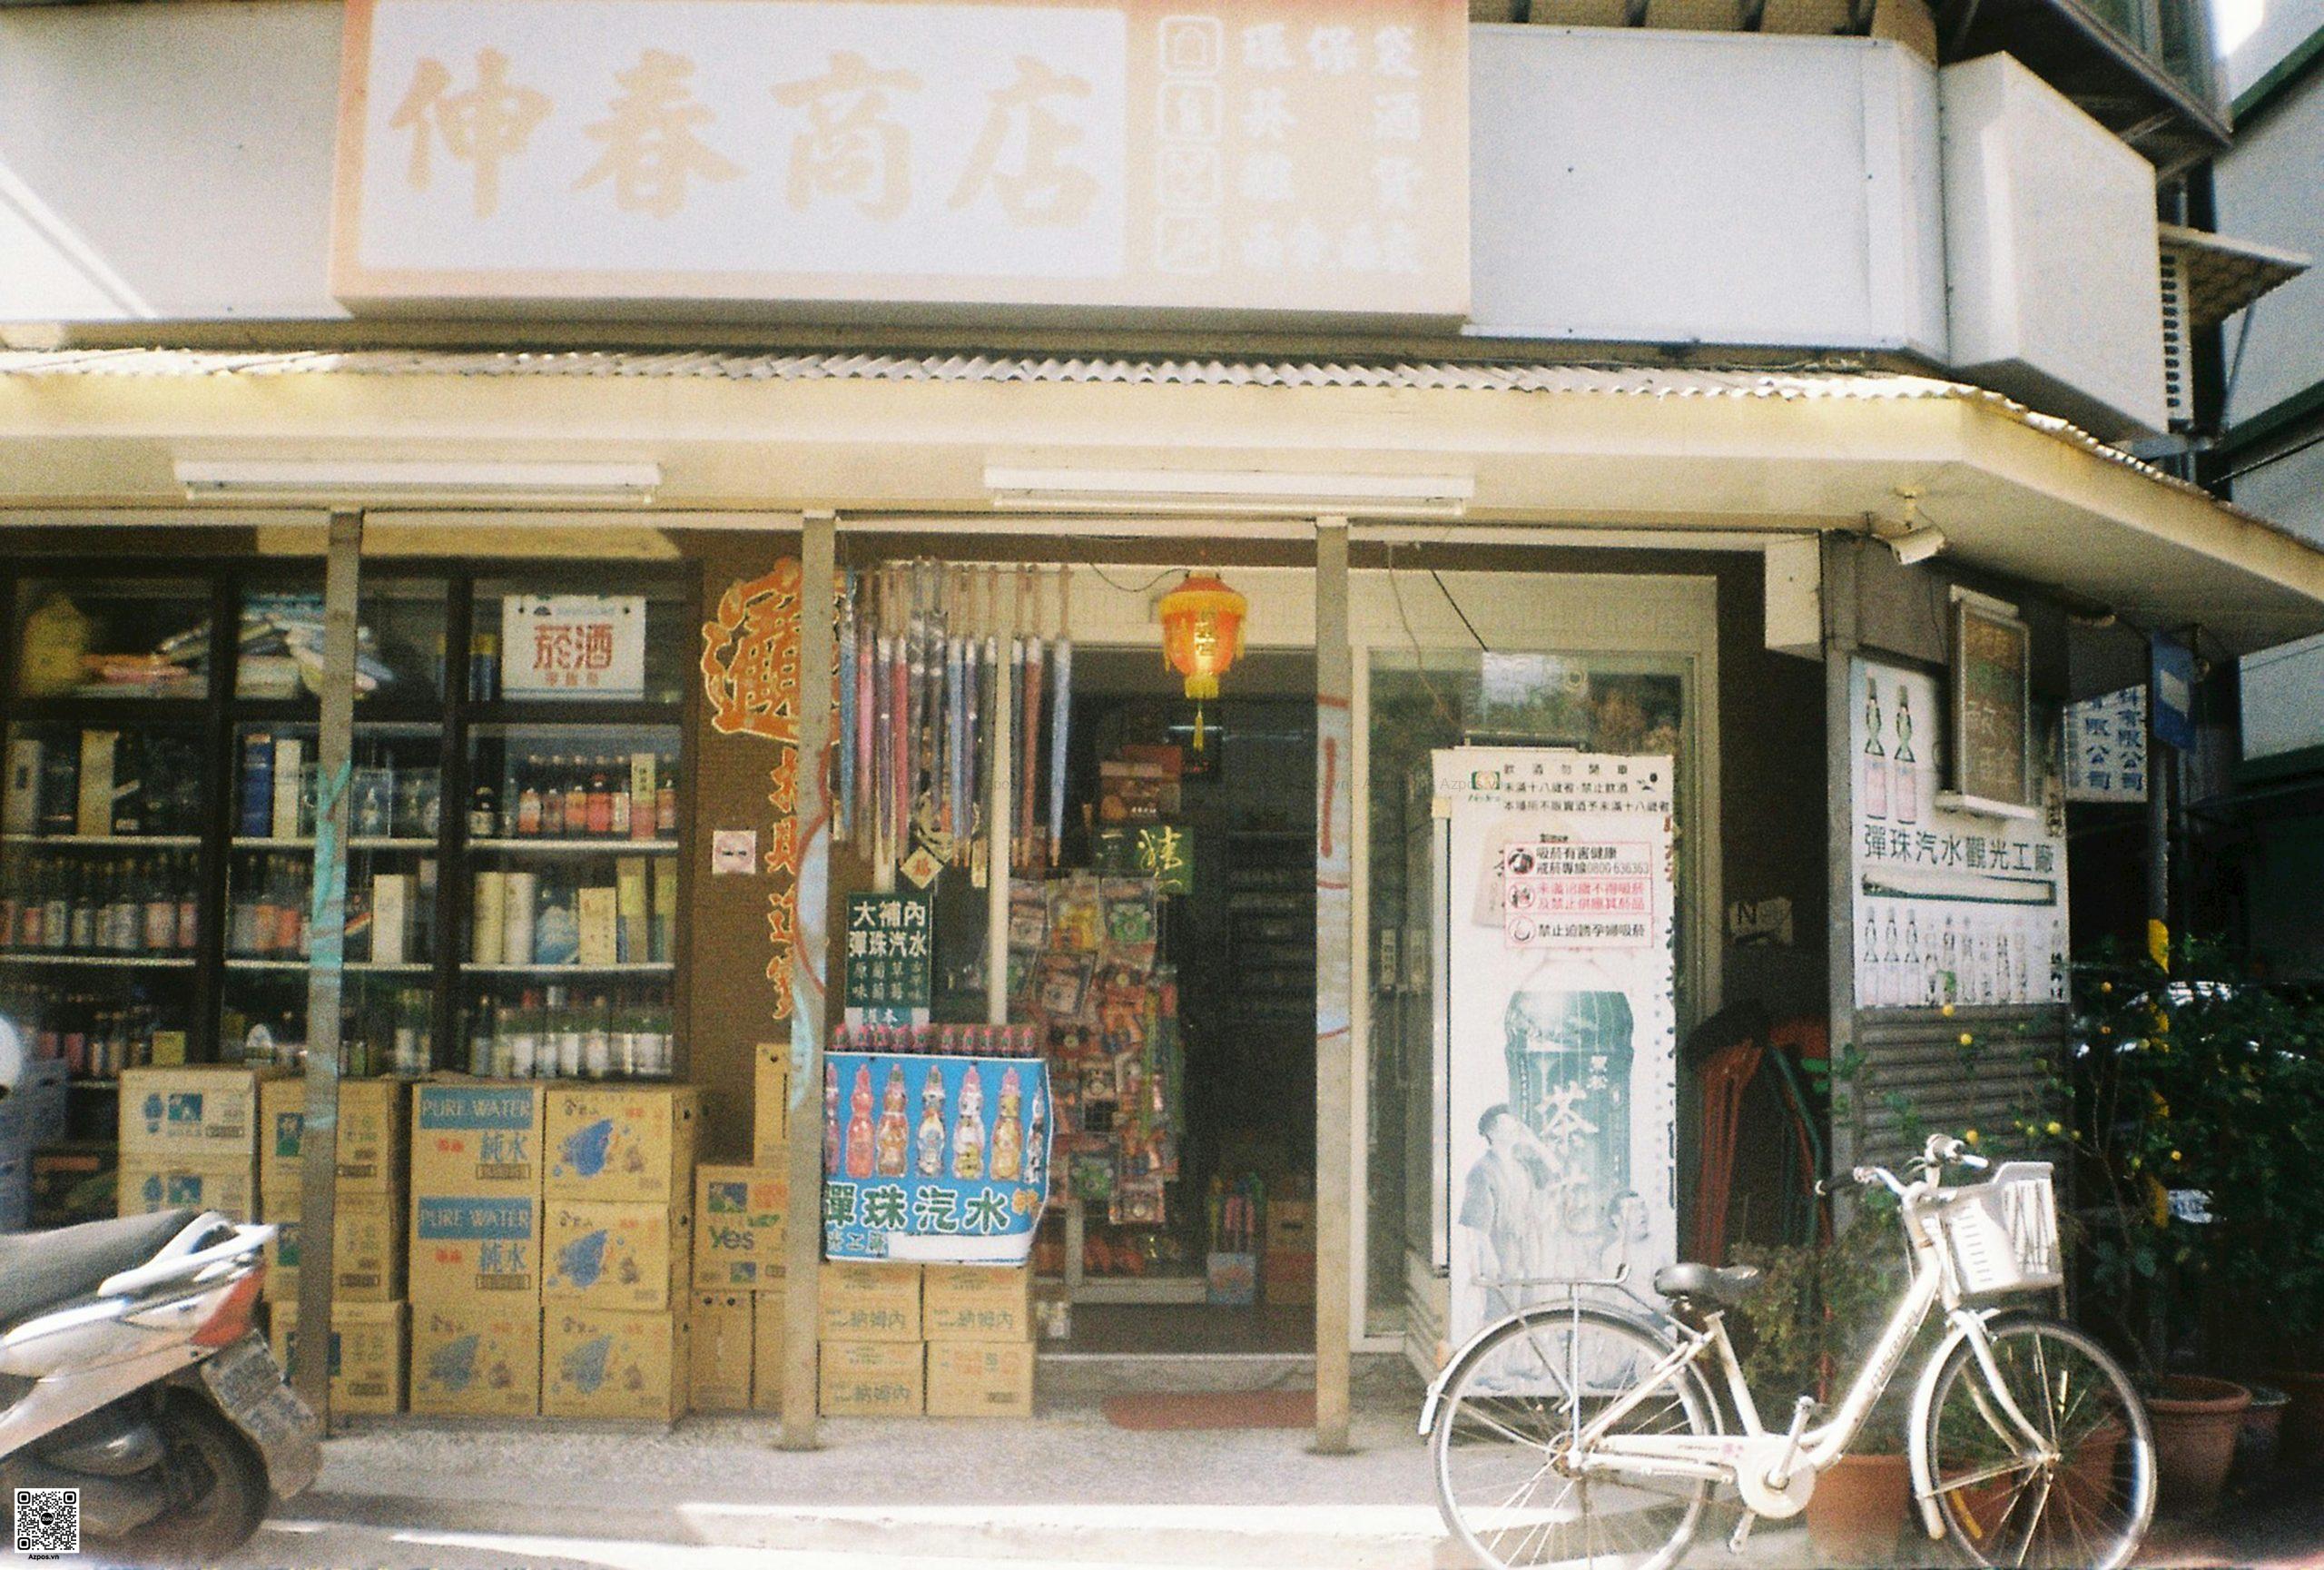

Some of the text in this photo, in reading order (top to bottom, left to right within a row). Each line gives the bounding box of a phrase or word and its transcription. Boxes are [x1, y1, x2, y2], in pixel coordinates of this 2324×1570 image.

[389, 47, 1102, 228] 伸春商店
[1865, 824, 2053, 873] 彈珠汽水觀光工廠
[849, 931, 927, 957] 彈珠汽水
[471, 1100, 530, 1118] WATER
